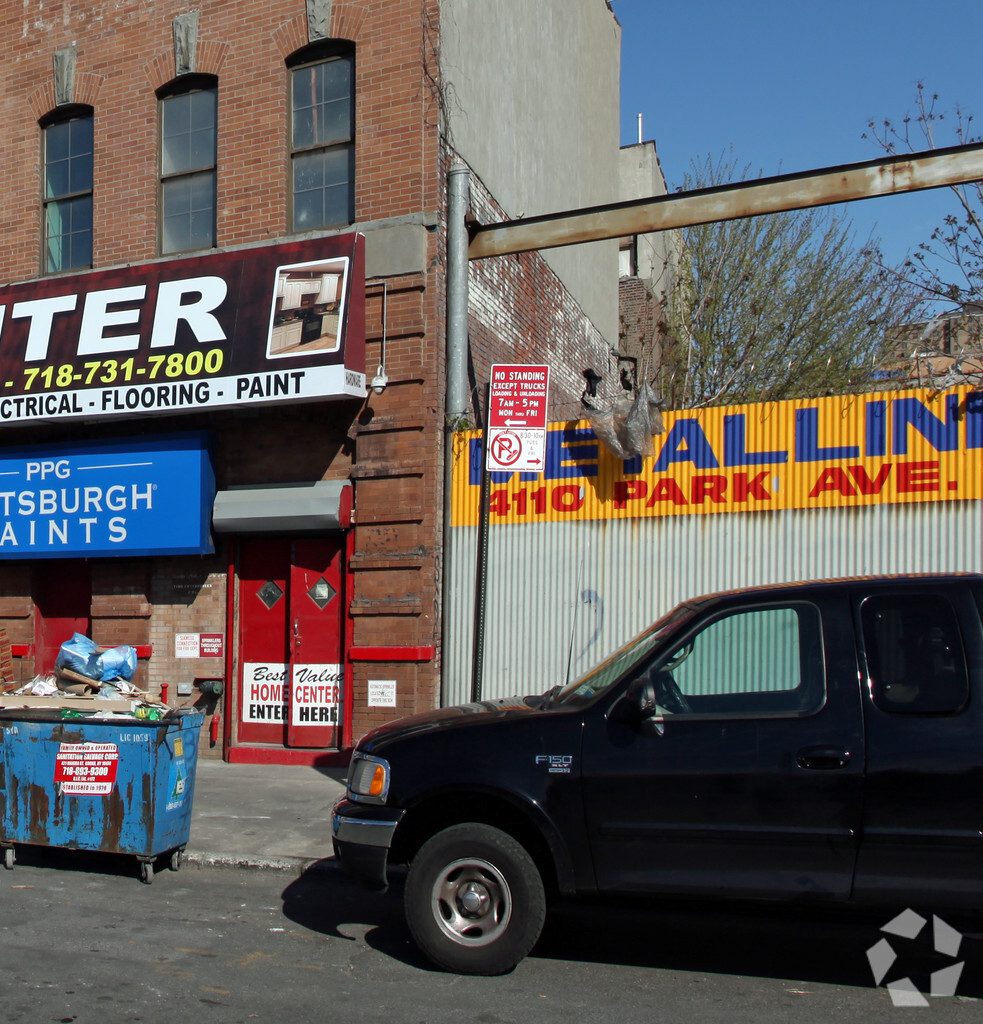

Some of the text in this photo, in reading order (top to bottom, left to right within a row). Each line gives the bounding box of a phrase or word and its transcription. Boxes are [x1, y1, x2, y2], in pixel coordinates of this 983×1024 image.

[23, 348, 224, 390] 718-731-7800
[494, 372, 545, 380] NO STANDING
[102, 382, 210, 411] FLOORING
[236, 372, 306, 400] PAINT
[26, 460, 71, 481] PPG
[478, 460, 958, 517] 4110 PARK AVE.
[253, 666, 344, 684] Best Value
[250, 684, 340, 704] HOME CENTER
[250, 704, 338, 722] ENTER HERE
[120, 733, 131, 742] LIC
